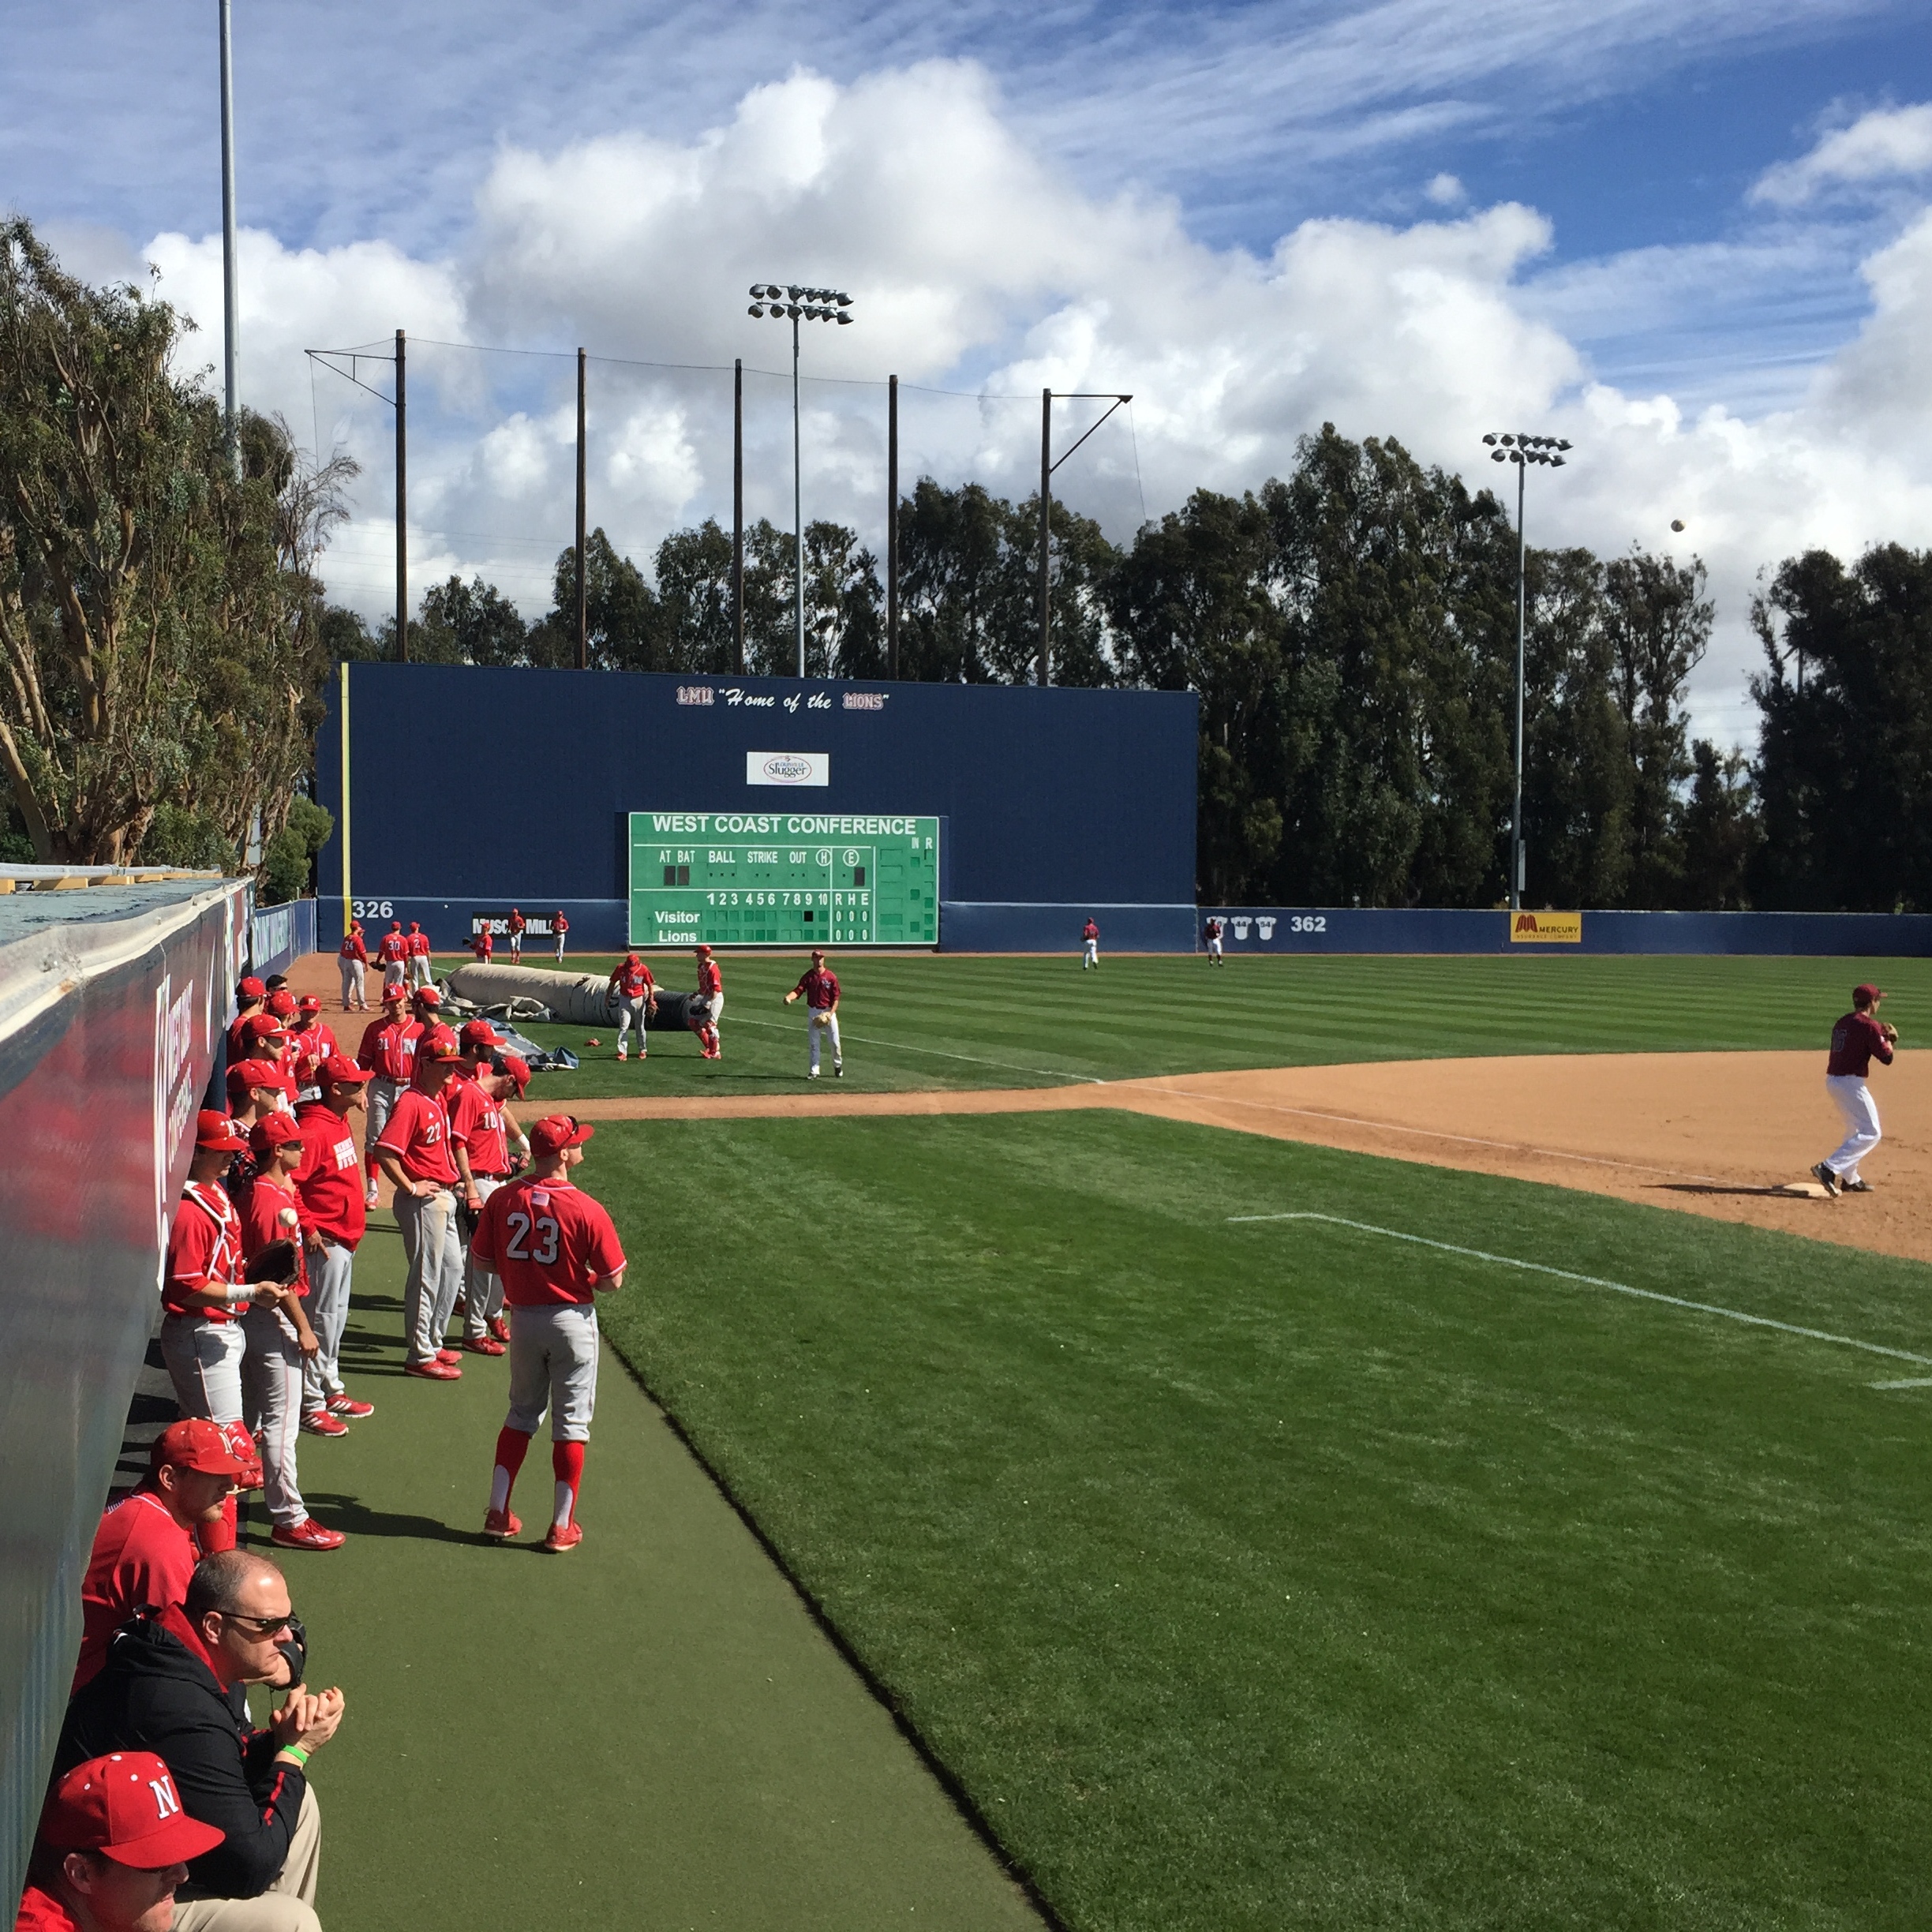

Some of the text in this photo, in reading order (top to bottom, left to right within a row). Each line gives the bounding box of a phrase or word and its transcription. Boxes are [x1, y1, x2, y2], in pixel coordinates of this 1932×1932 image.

[676, 686, 714, 706] LMU
[784, 694, 800, 713] of
[807, 691, 832, 709] the
[769, 763, 806, 778] Slugger
[653, 815, 916, 835] WEST COAST CONFERENCE
[925, 837, 933, 849] R
[659, 850, 671, 863] AT
[677, 850, 695, 863] BAT
[709, 851, 736, 863] BALL
[747, 851, 778, 863] STRIKE
[789, 852, 807, 863] OUT
[706, 893, 868, 905] 1 2 3 4 5 6 7 8 9 10 R H E
[352, 900, 394, 919] 326
[655, 911, 867, 923] Visitor 0 0 0
[473, 918, 524, 934] MUSC
[1290, 916, 1327, 932] 362
[413, 939, 421, 949] 2
[659, 930, 867, 942] Lions 0 0 0
[344, 940, 354, 951] 24
[388, 940, 401, 951] 30
[377, 1038, 390, 1050] 31
[484, 1111, 498, 1129] 10
[227, 1120, 236, 1137] N
[426, 1121, 441, 1144] 22
[506, 1211, 560, 1264] 23
[218, 1431, 234, 1455] N
[148, 1774, 179, 1819] N
